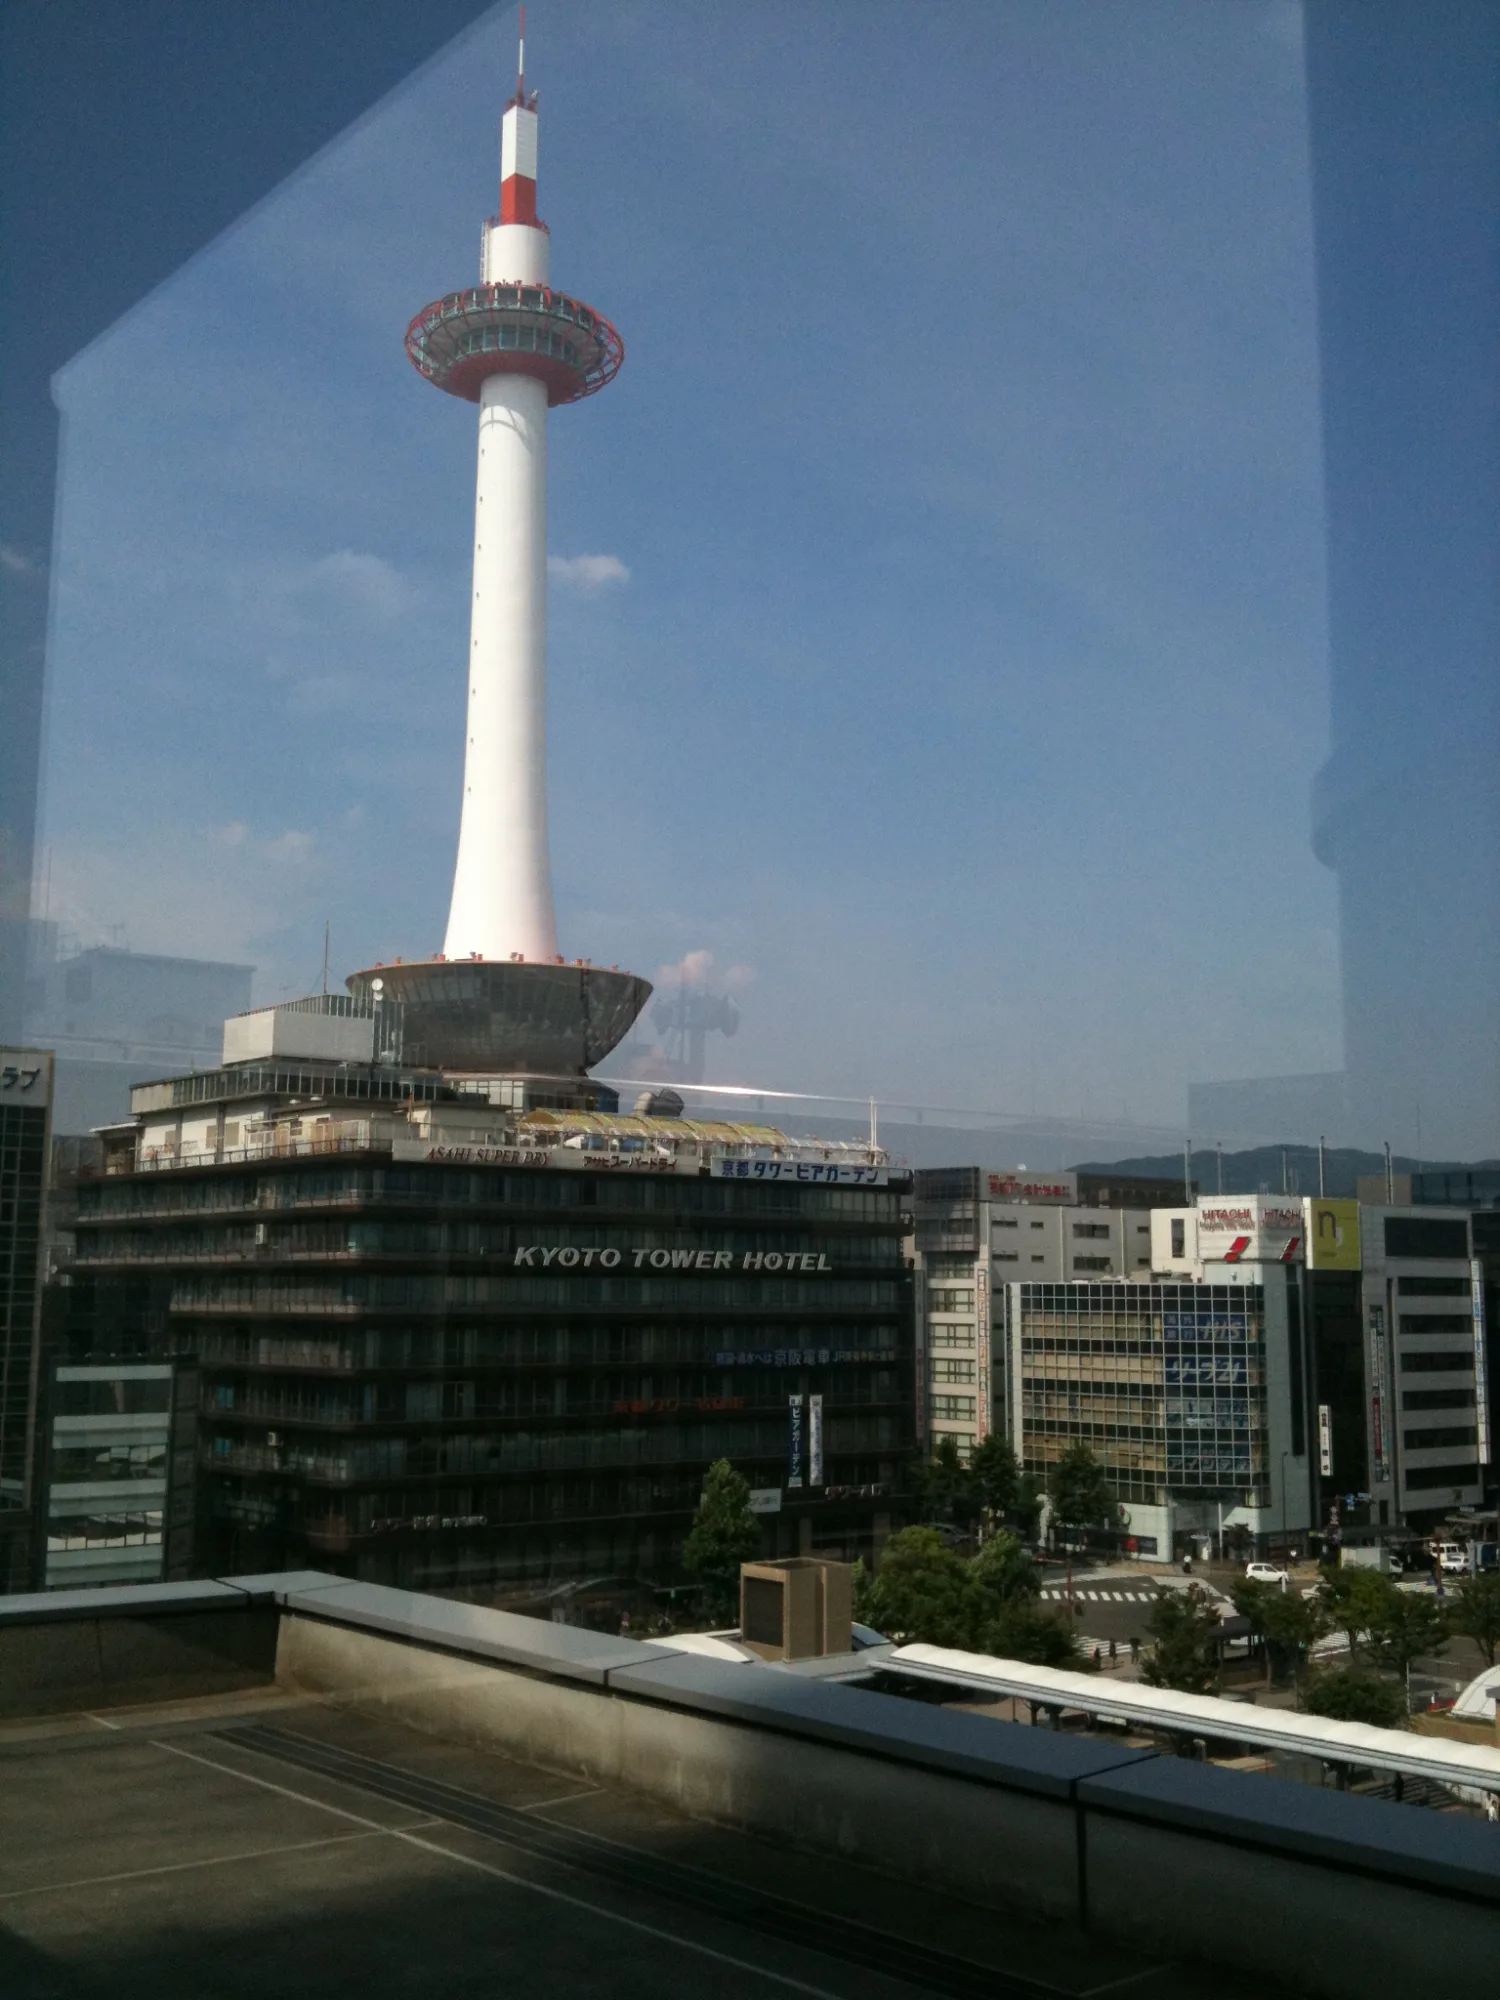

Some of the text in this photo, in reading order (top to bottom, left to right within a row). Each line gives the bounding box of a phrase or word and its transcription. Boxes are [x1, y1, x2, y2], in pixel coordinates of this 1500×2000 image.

[428, 1147, 552, 1167] ASAHI SUPER DRY
[583, 1155, 677, 1172] アサヒスーパードライ
[722, 1160, 879, 1183] 京都タワービアガーデン
[1203, 1209, 1250, 1220] HITACHI
[1265, 1208, 1301, 1221] HITACHI
[514, 1246, 832, 1272] KYOTO TOWER HOTEL
[792, 1407, 802, 1476] ビアガーデン
